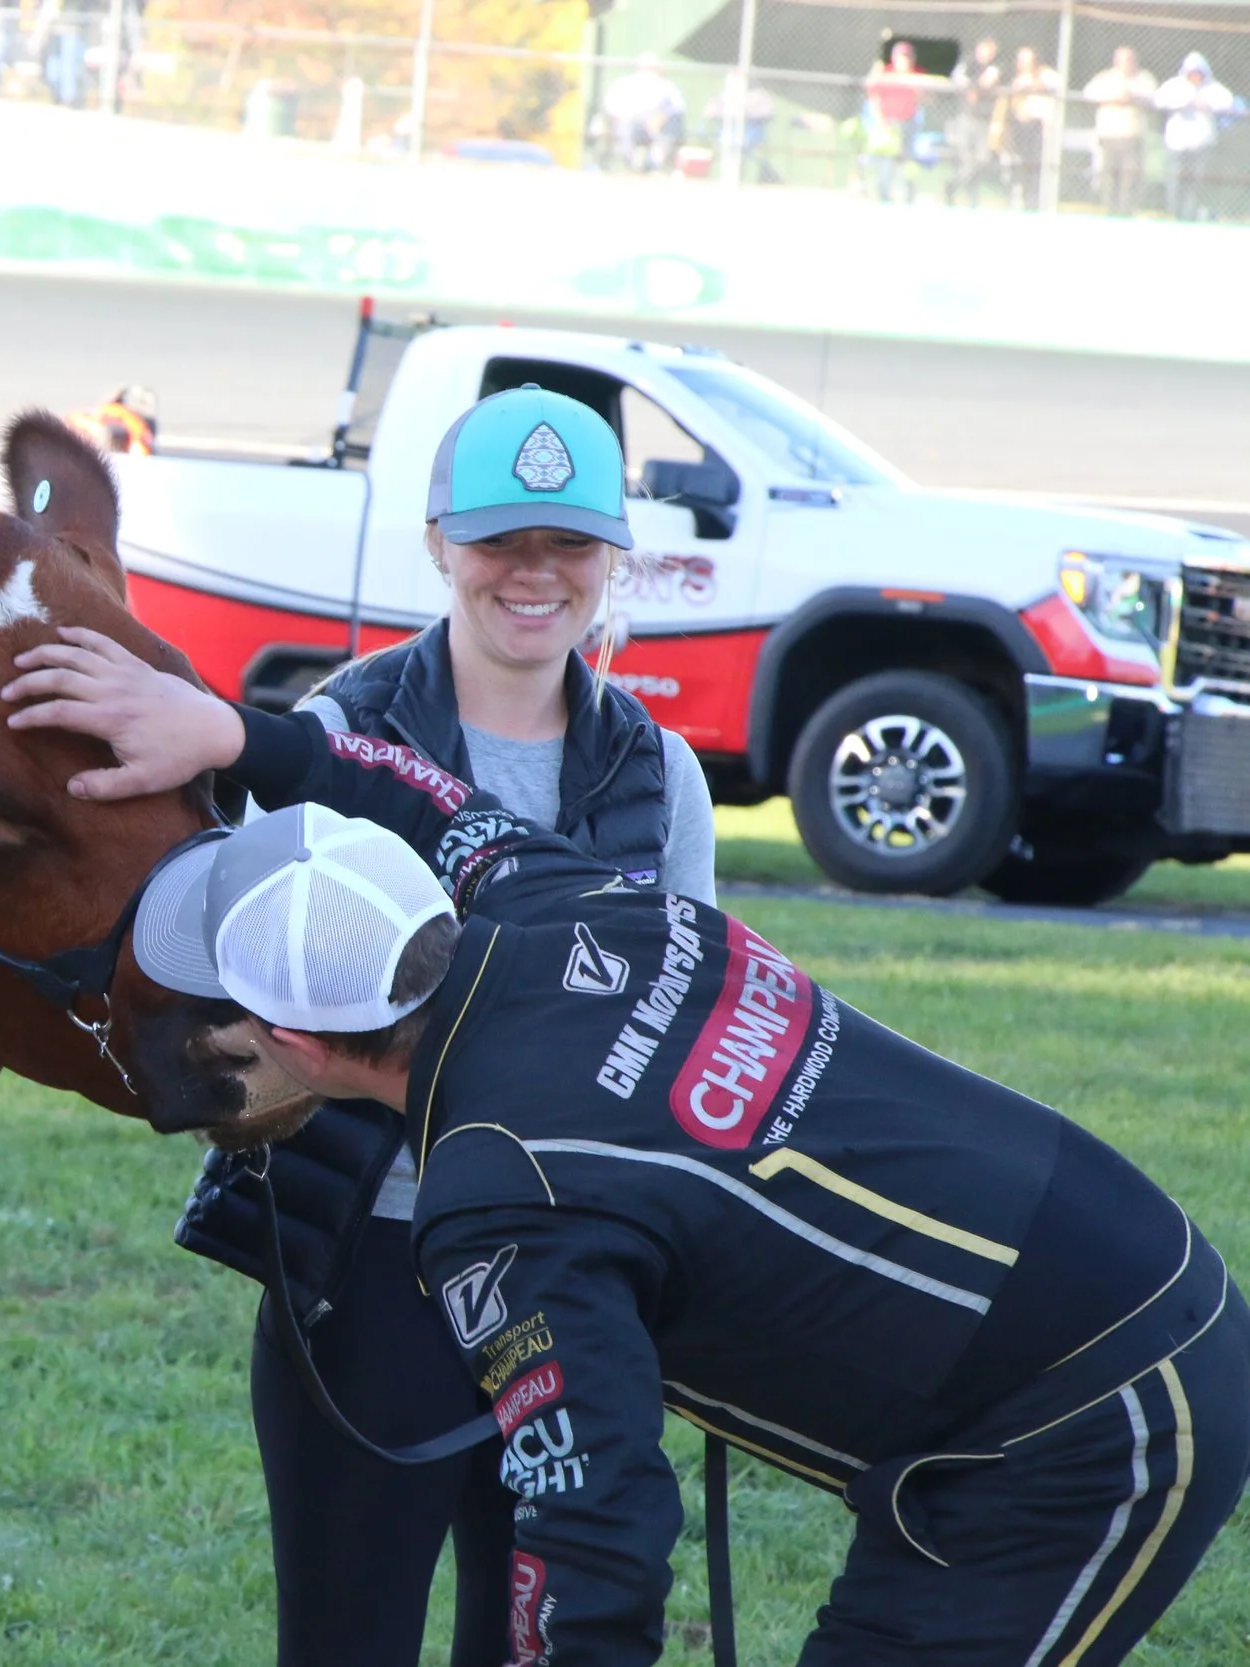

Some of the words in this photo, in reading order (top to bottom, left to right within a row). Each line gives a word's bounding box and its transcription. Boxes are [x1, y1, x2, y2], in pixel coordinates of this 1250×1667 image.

[596, 1023, 659, 1100] CMK
[762, 1116, 793, 1146] THE
[786, 1041, 833, 1119] HARDWOOD
[481, 1311, 545, 1360] Transport
[491, 1330, 553, 1390] CHAMPEAU
[497, 1370, 556, 1430] HAMPEAU
